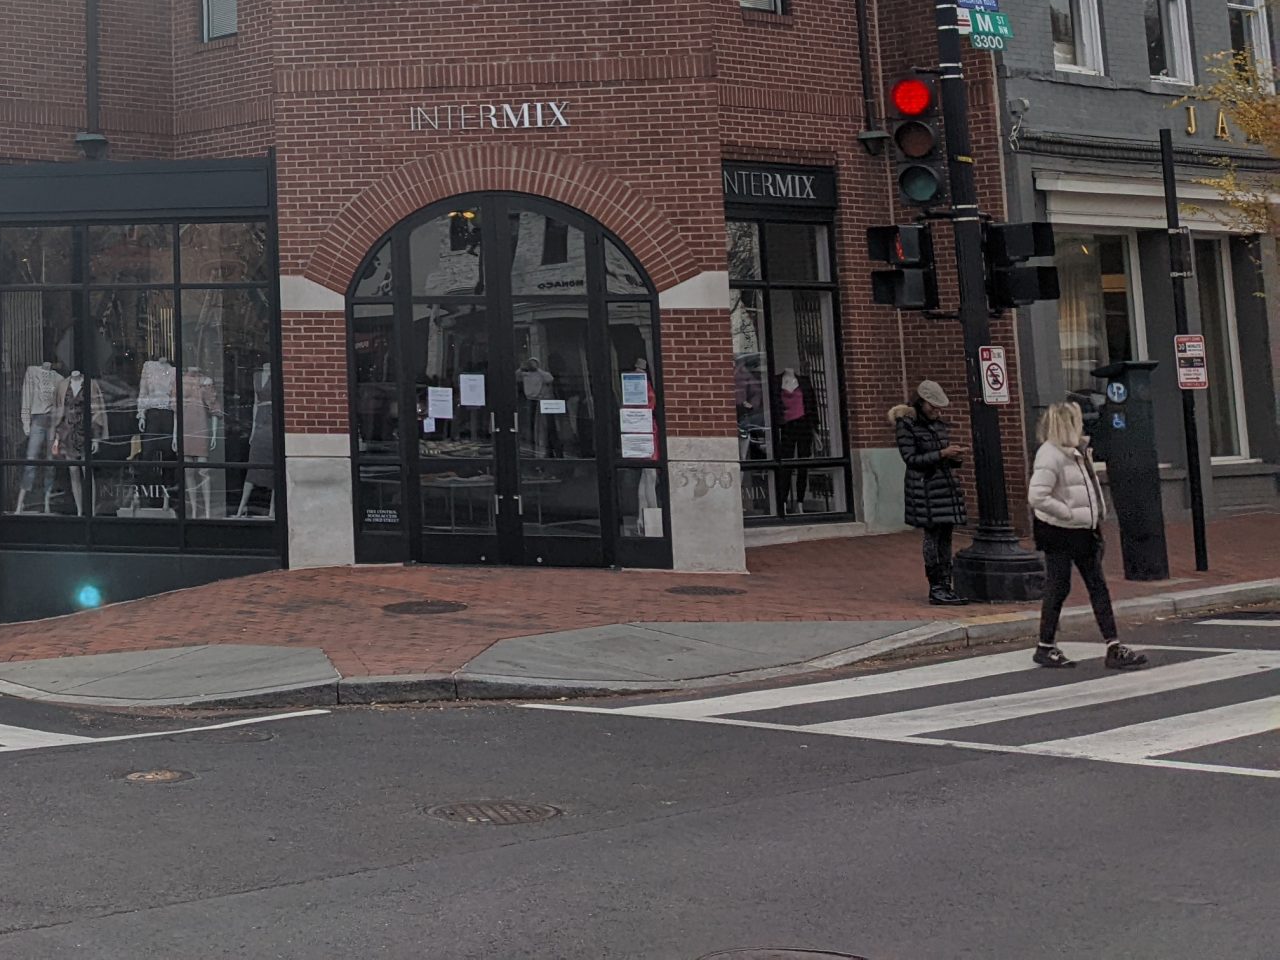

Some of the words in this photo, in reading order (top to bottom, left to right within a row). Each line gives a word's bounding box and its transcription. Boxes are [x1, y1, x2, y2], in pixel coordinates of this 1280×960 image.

[975, 13, 995, 33] M
[996, 15, 1005, 25] ST
[998, 25, 1009, 35] NW
[973, 34, 1004, 49] 3300
[410, 101, 570, 131] INTERMIX
[723, 170, 817, 199] NTERMIX
[100, 484, 171, 498] INTERMIX
